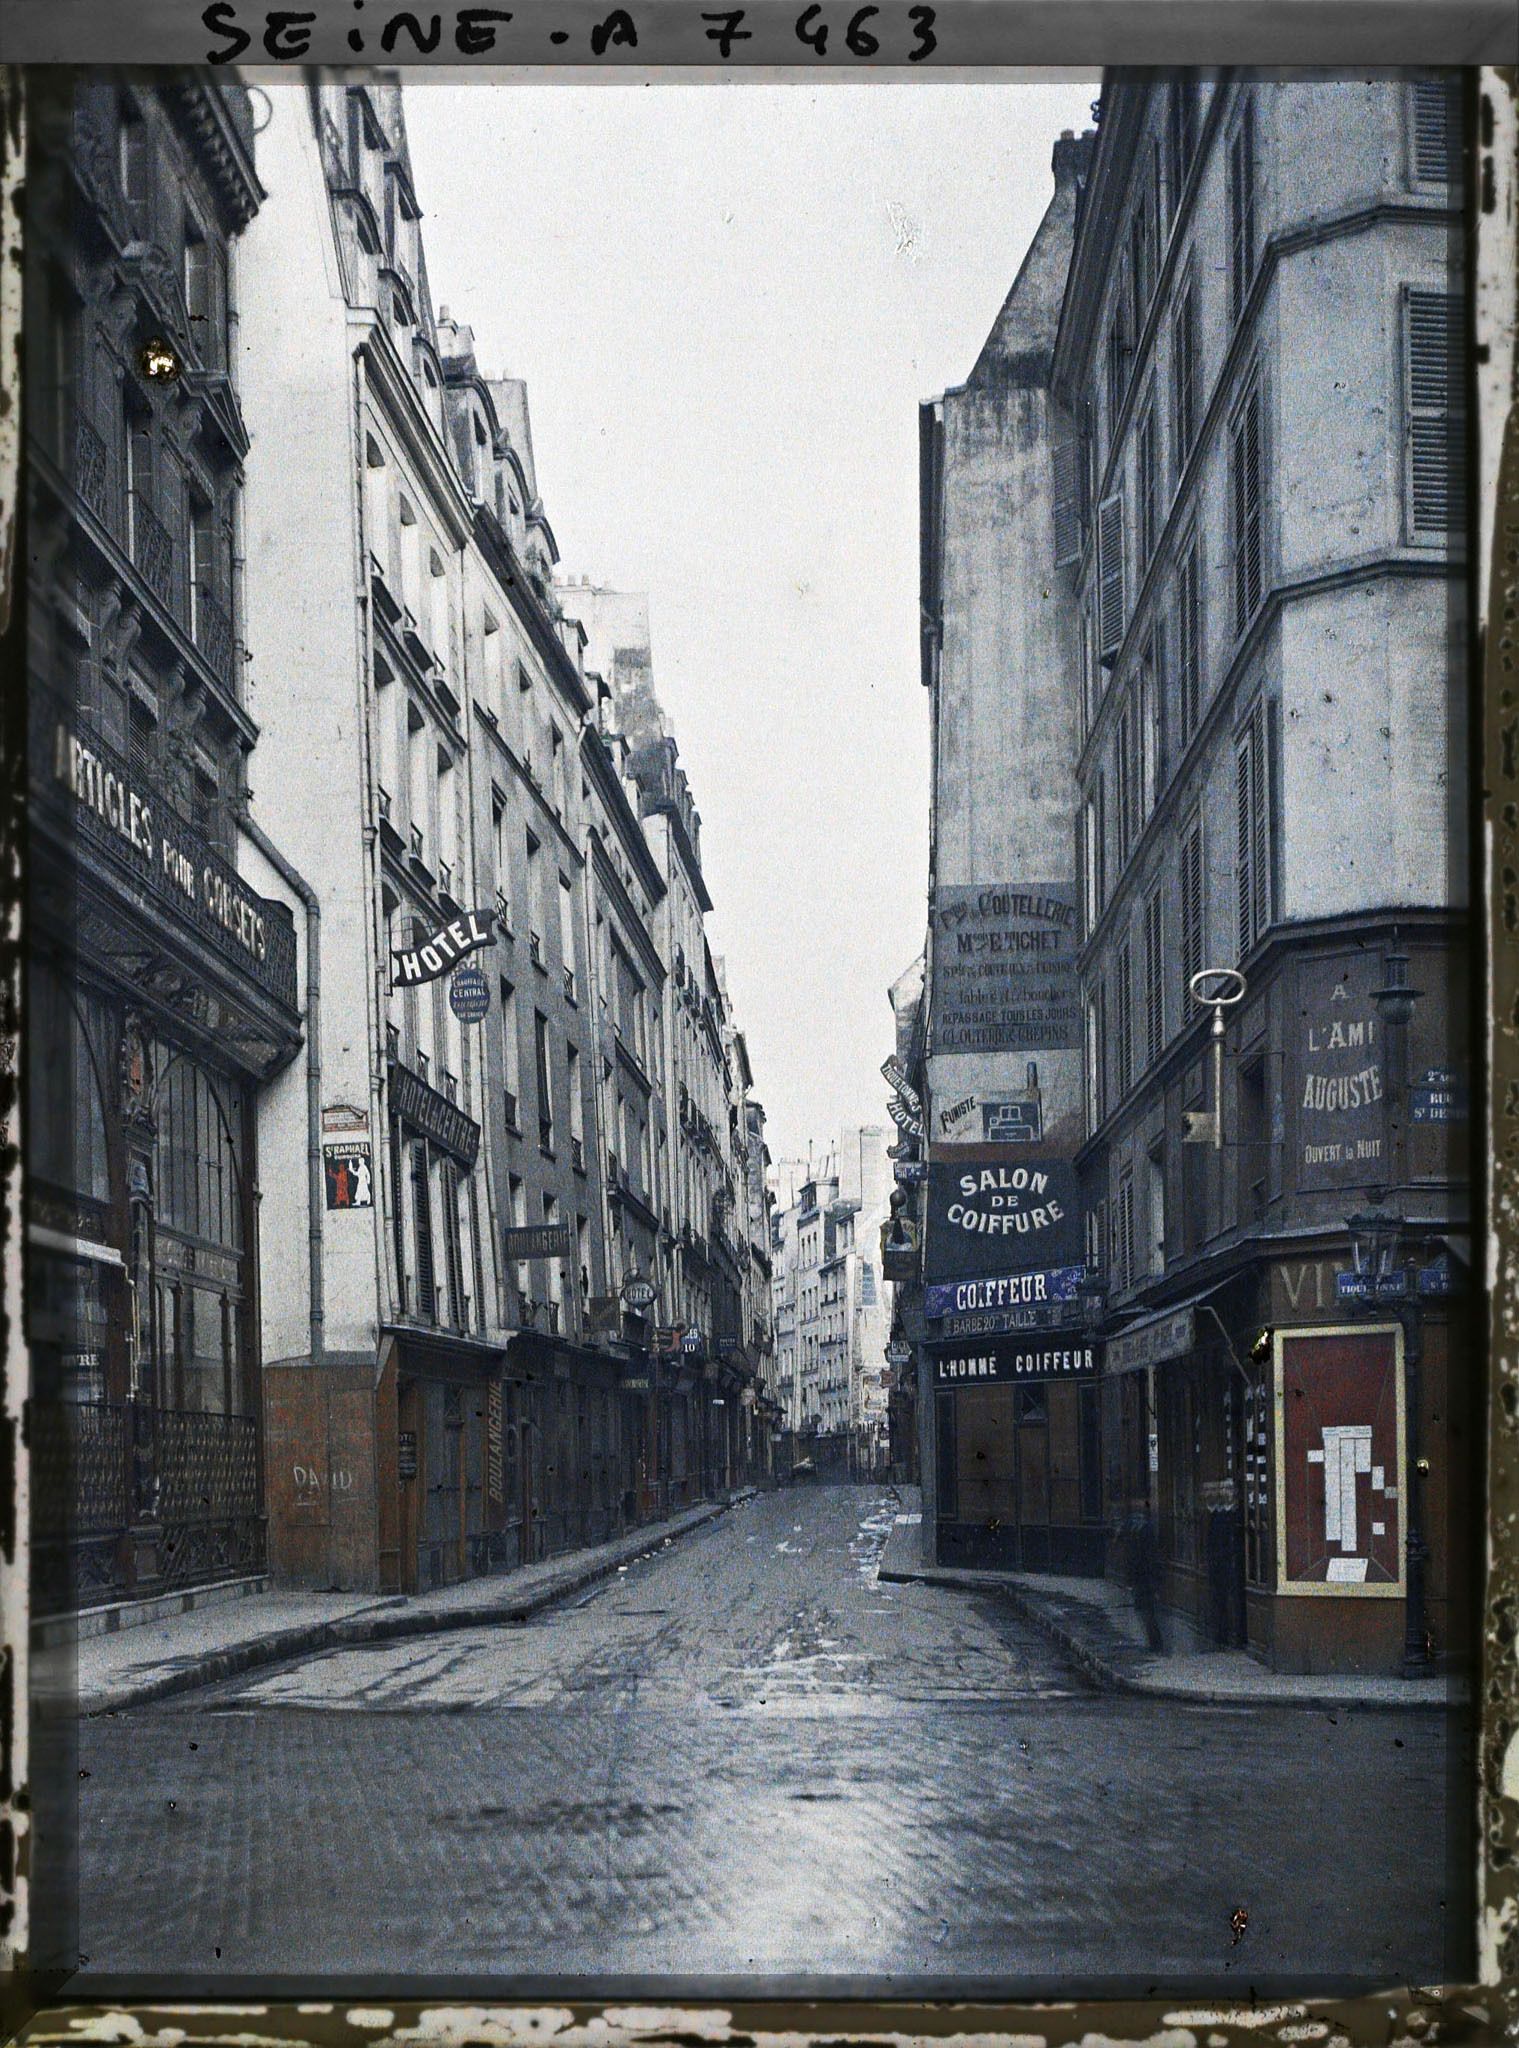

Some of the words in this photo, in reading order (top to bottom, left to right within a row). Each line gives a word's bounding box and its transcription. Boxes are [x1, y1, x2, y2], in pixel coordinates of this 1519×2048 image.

[591, 9, 638, 54] A
[705, 11, 752, 58] 7
[163, 839, 195, 899] POUR
[204, 866, 265, 960] CORSETS
[401, 915, 488, 980] HOTEL
[453, 988, 486, 998] CENTRAL
[1044, 1006, 1077, 1020] JOURS
[1308, 1021, 1374, 1052] L'AMI
[1302, 1065, 1383, 1112] AUGUSTE
[888, 1102, 924, 1137] HOTEL
[940, 1096, 977, 1135] FUMISTE
[1305, 1144, 1342, 1164] OUVERT
[1357, 1139, 1381, 1159] NUIT
[959, 1167, 1049, 1197] SALON
[947, 1199, 1065, 1235] COIFFURE
[991, 1196, 1019, 1207] DE
[956, 1273, 1048, 1311] COIFFEUR
[953, 1316, 983, 1334] BARBE
[1003, 1310, 1037, 1329] TAILLE
[1015, 1350, 1094, 1374] COIFFEUR
[489, 1380, 503, 1503] BOULANGERIE
